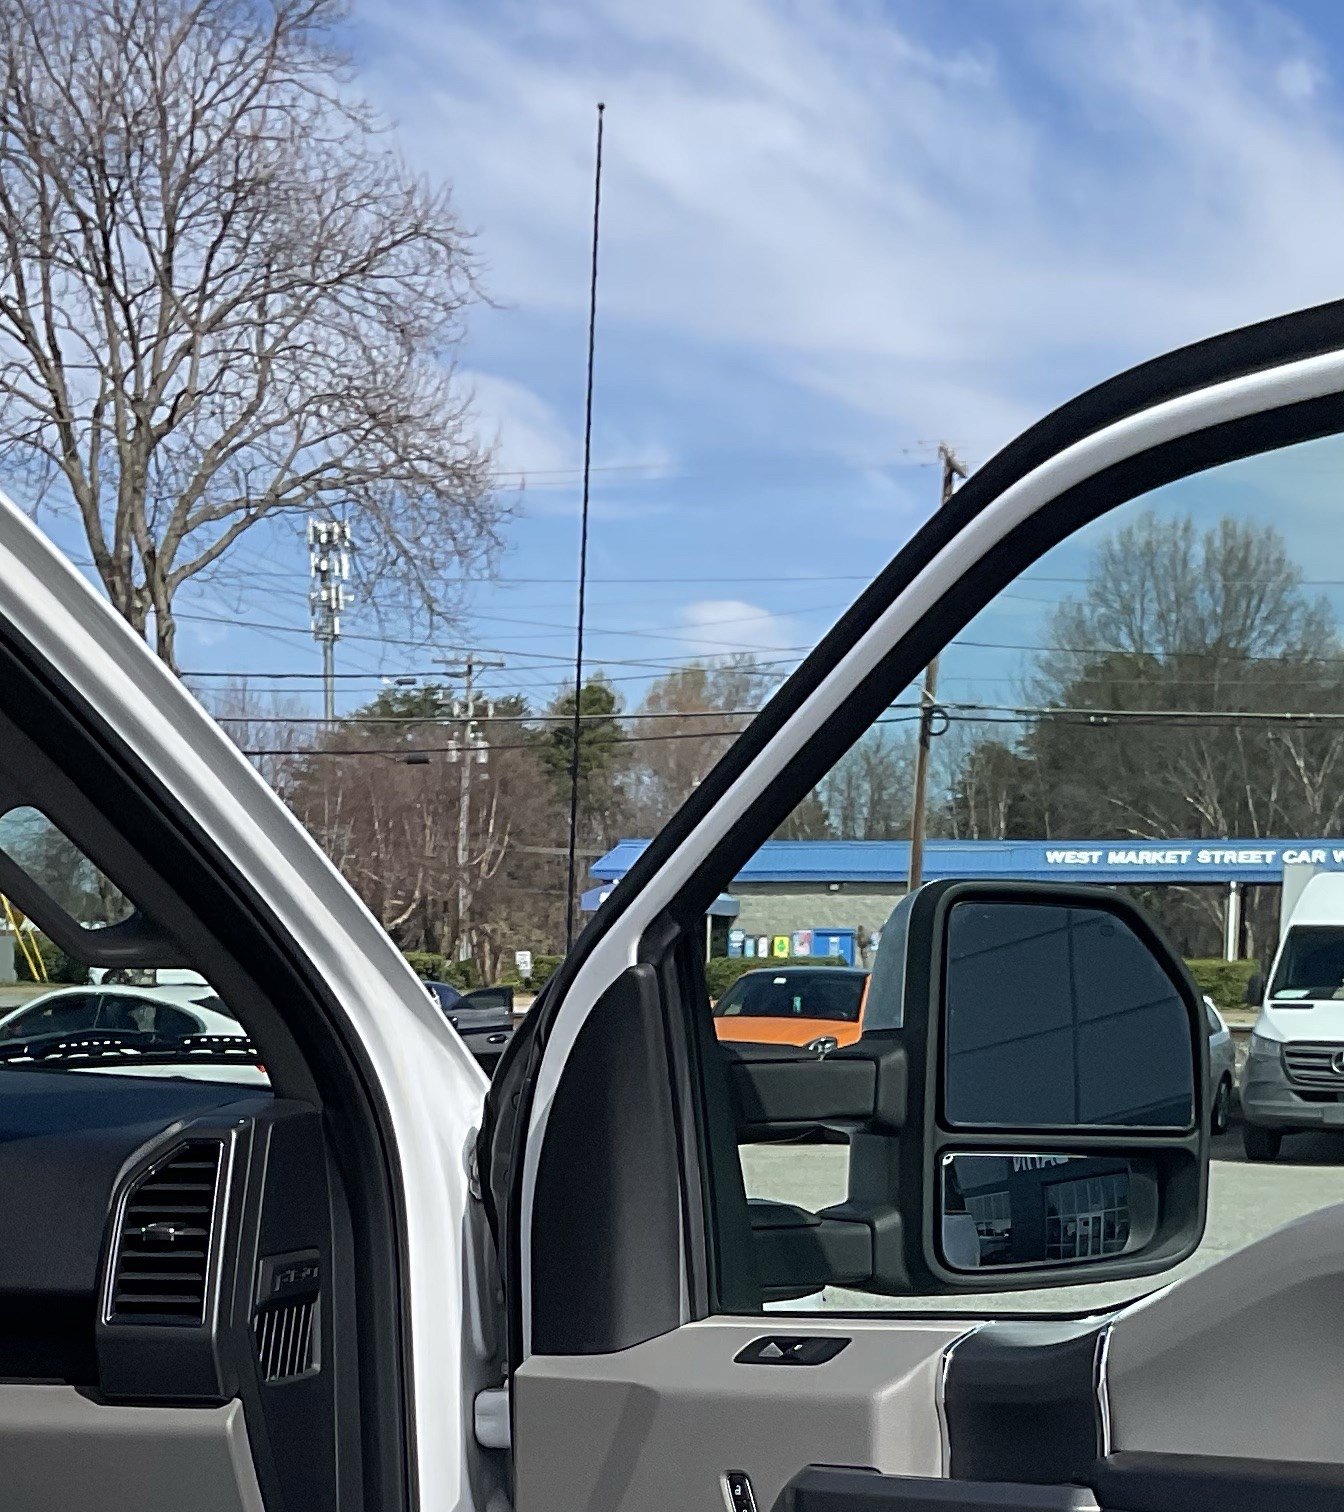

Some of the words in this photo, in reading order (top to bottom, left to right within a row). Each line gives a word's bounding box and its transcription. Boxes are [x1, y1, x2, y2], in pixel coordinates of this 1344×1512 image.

[1046, 850, 1102, 864] WEST
[1107, 850, 1192, 864] MARKET
[1196, 850, 1277, 864] STREET
[1282, 850, 1326, 864] CAR
